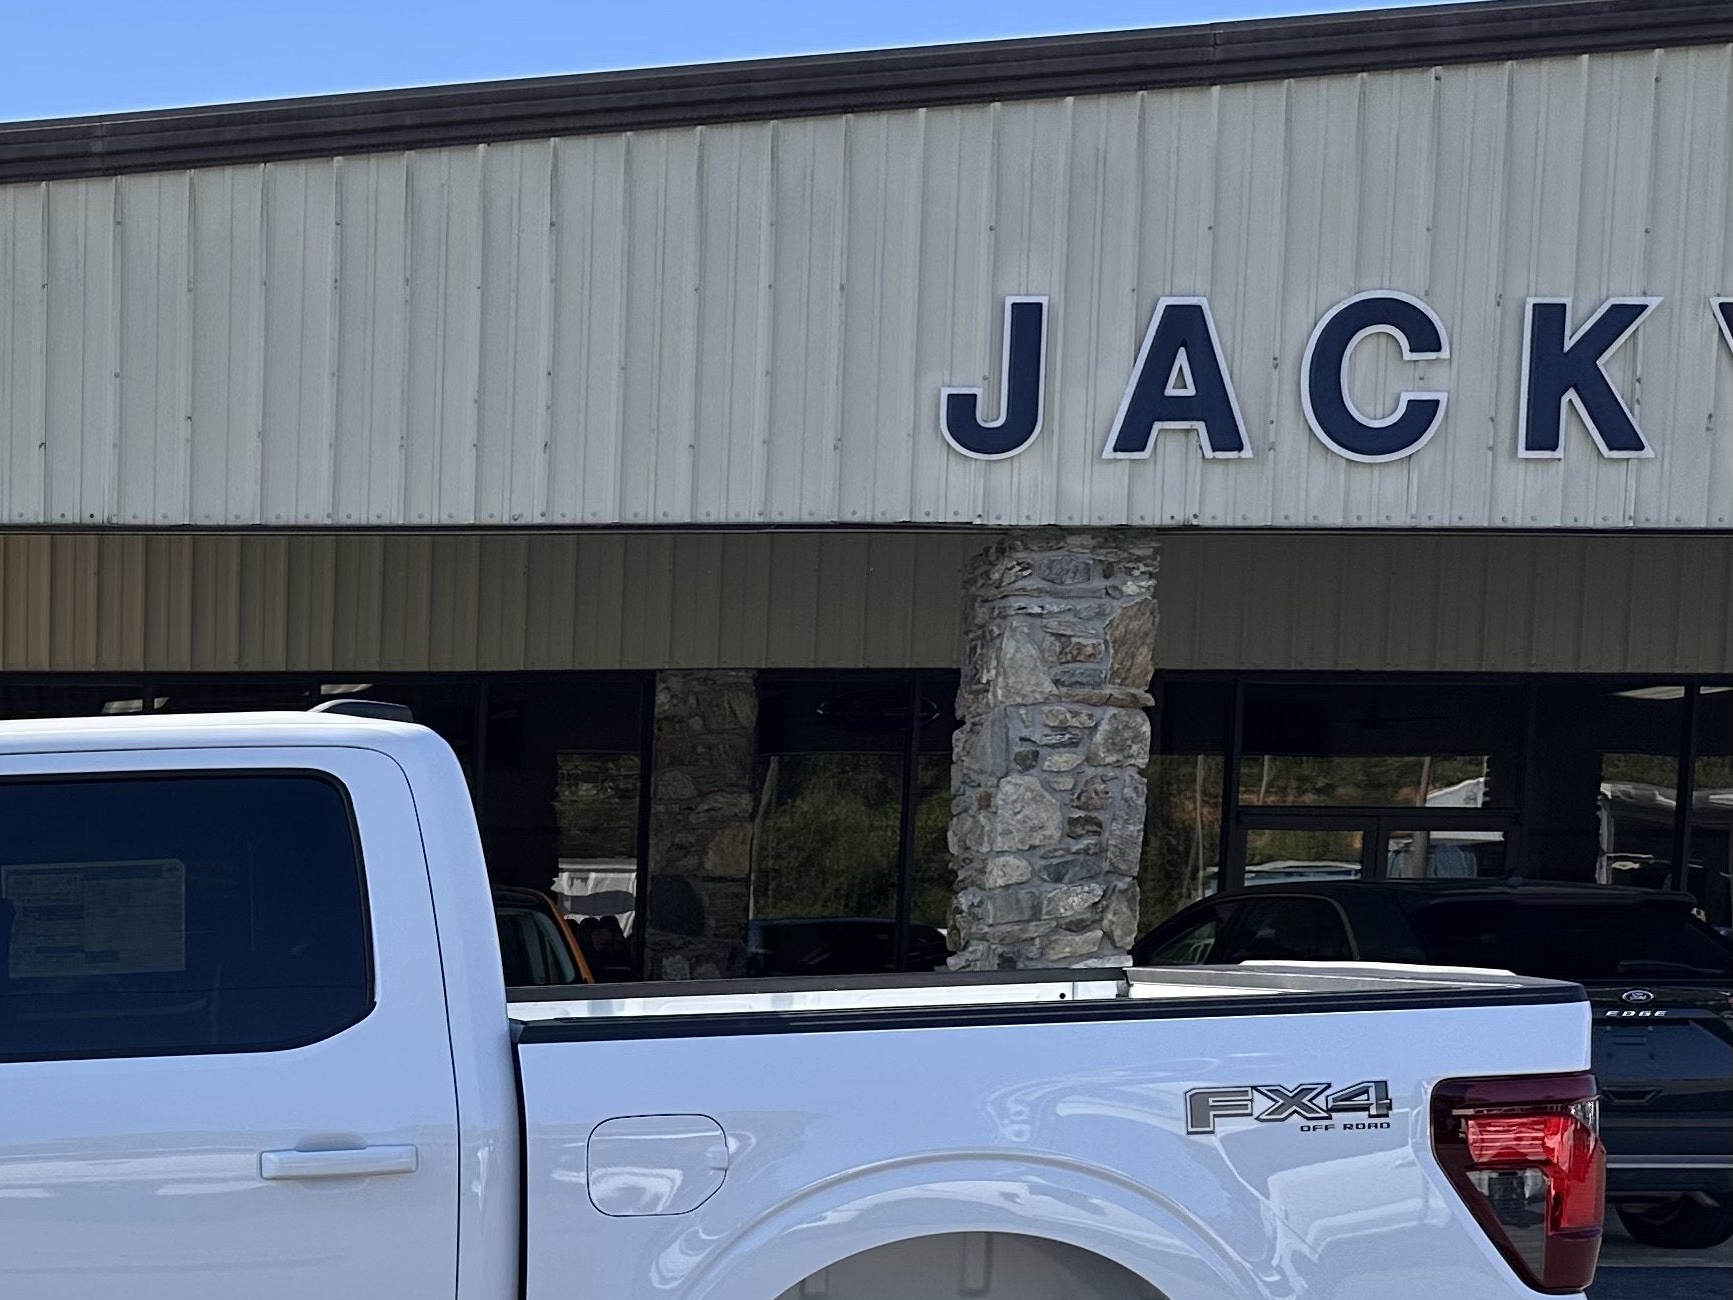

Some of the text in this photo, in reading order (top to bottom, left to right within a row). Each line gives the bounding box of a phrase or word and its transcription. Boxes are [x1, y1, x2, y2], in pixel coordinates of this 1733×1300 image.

[940, 289, 1733, 463] JACK
[1185, 1080, 1392, 1135] FX4
[1300, 1122, 1390, 1132] OFF ROAD
